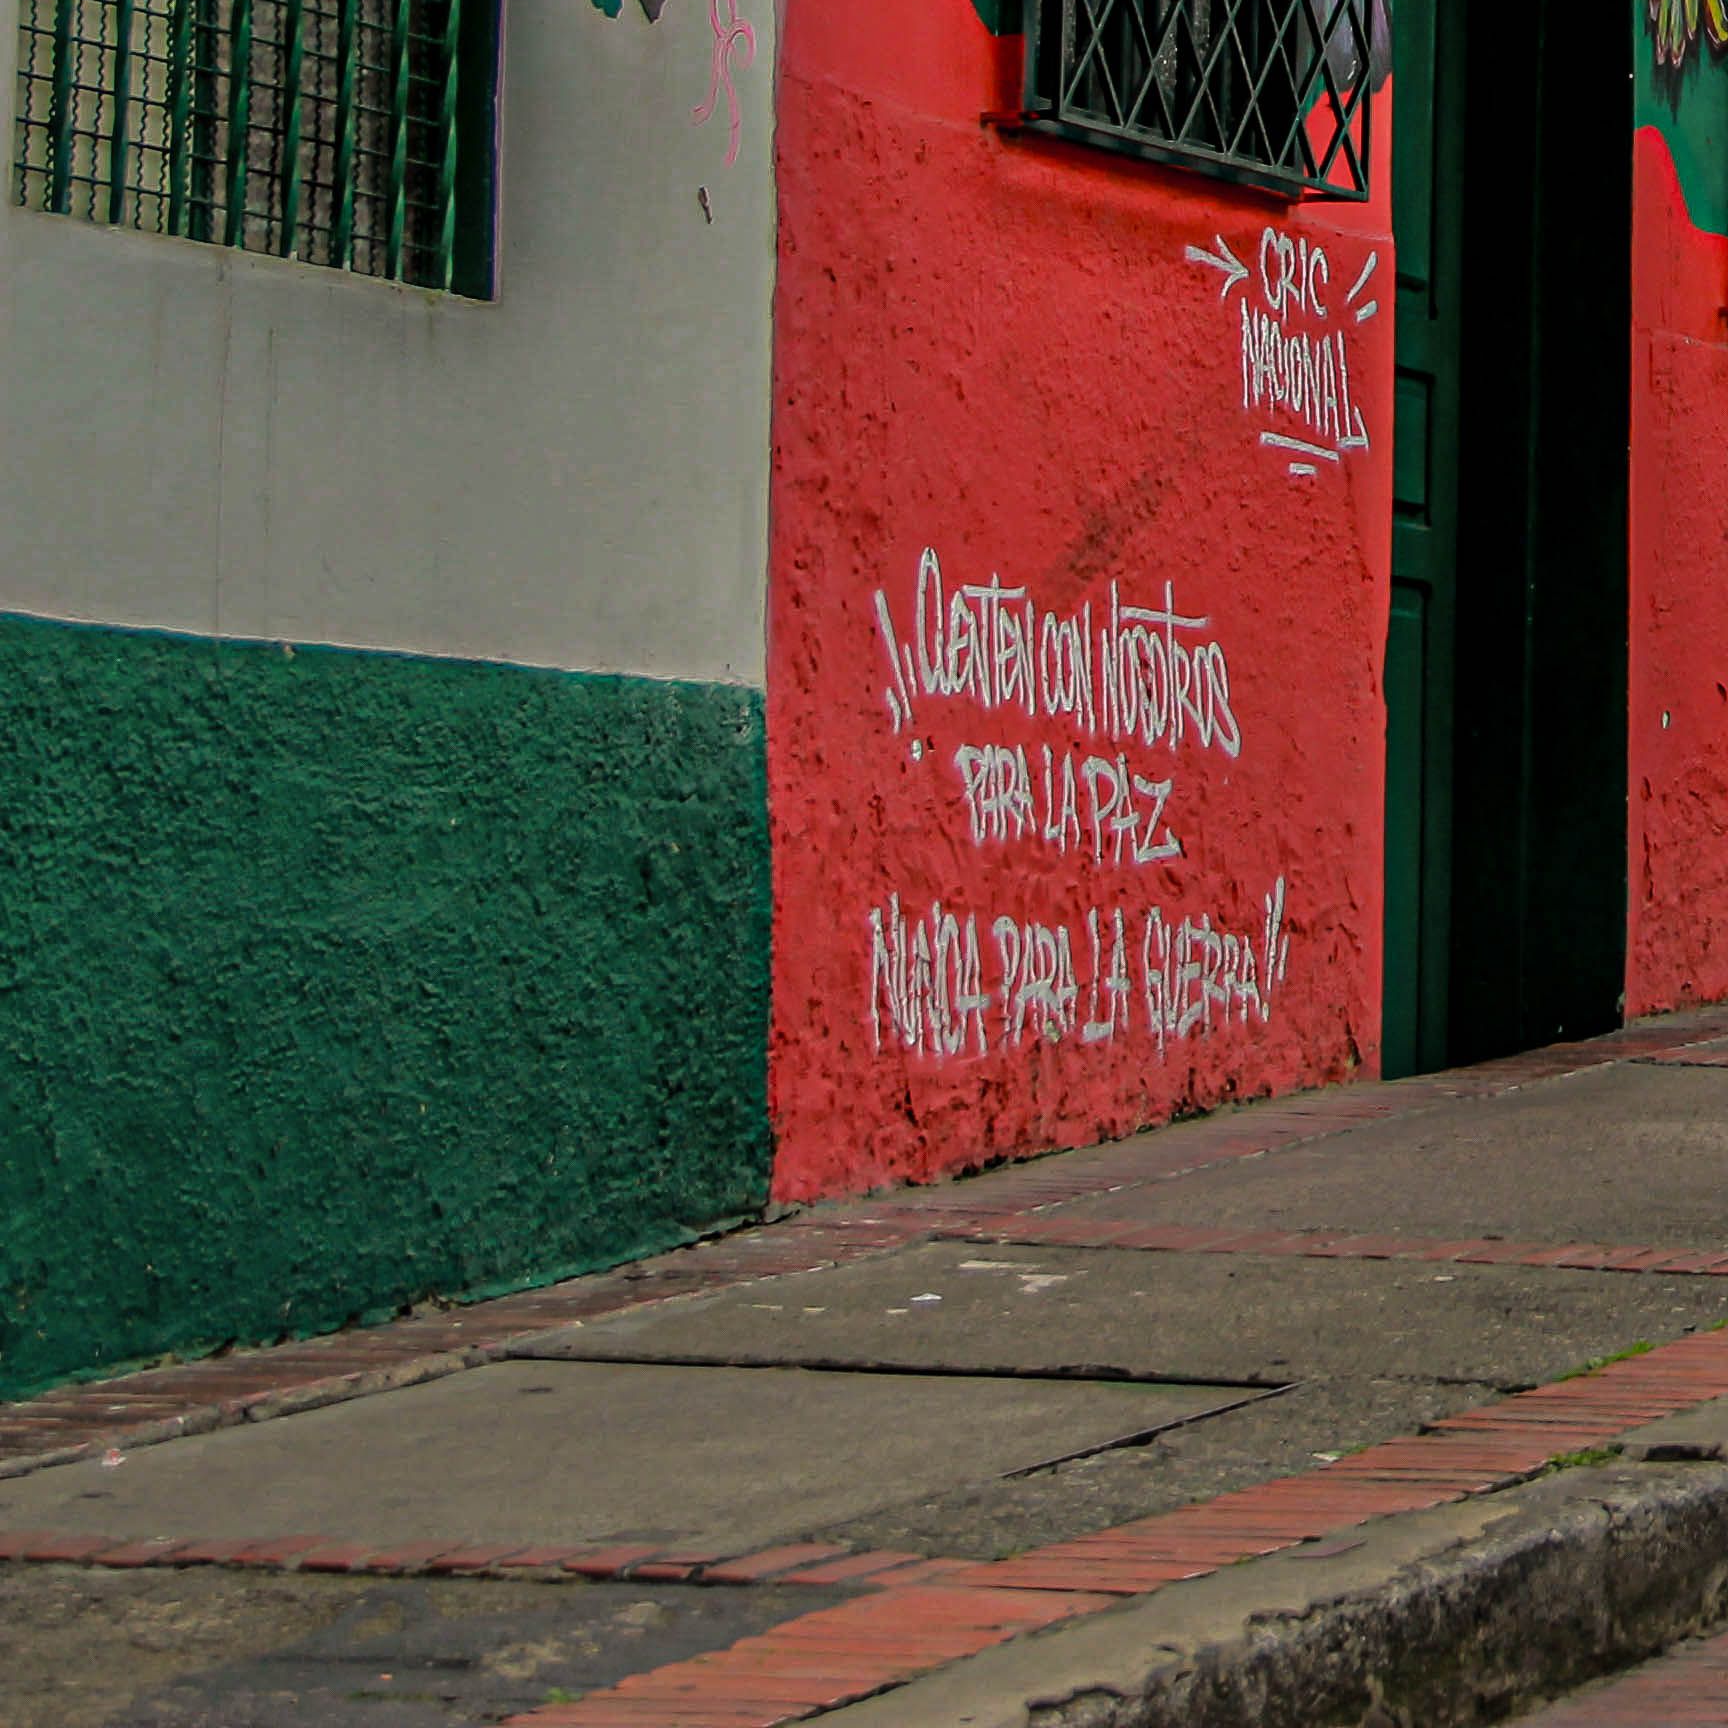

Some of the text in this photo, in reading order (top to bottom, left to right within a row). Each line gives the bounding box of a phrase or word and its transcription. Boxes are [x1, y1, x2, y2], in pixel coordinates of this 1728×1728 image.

[1260, 227, 1329, 323] CRIC
[1240, 296, 1370, 452] NACIONAL
[1041, 600, 1096, 736] CON
[1102, 578, 1242, 758] NOSOTROS
[954, 742, 1183, 865] PARA LA PAZ
[868, 890, 991, 1059] NUNCA
[993, 915, 1079, 1049] PARA
[1082, 905, 1132, 1044] LA
